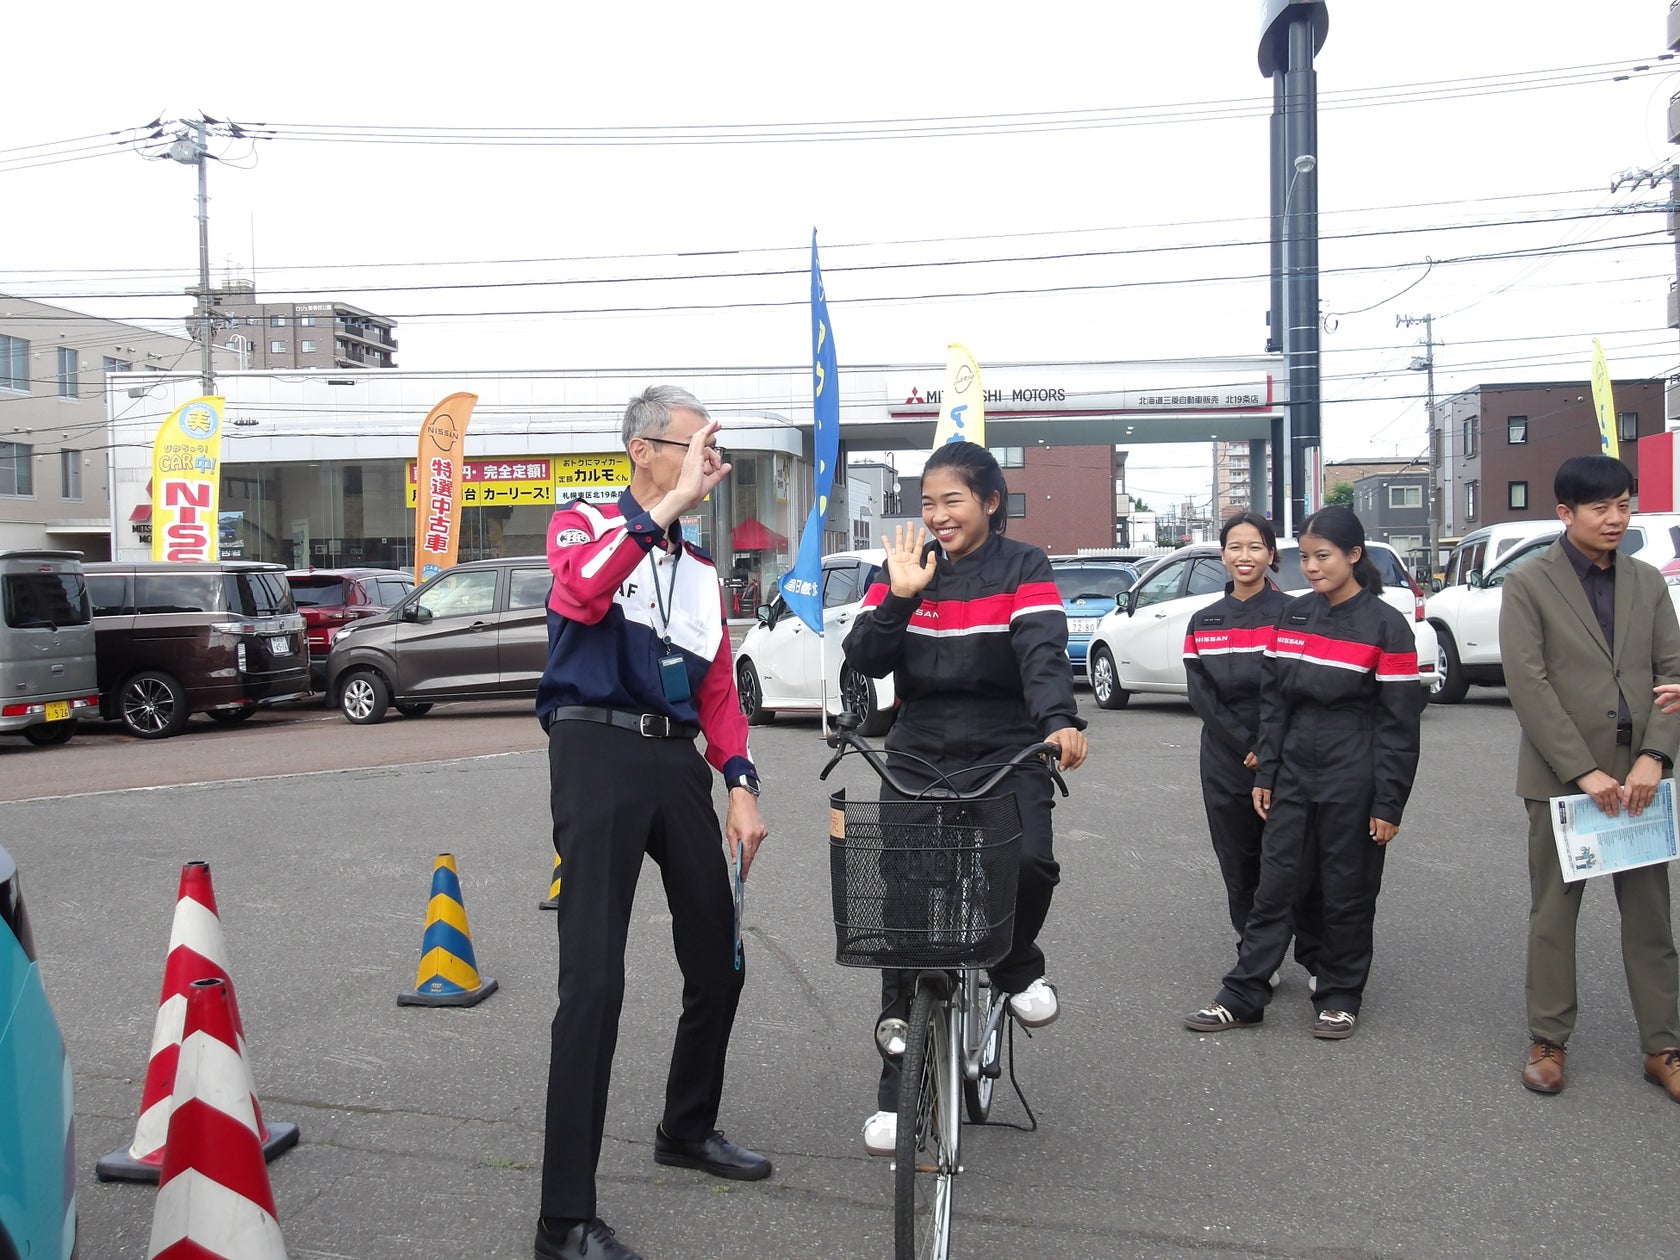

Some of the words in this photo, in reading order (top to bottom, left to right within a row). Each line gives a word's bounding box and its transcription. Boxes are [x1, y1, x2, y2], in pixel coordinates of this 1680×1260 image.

[926, 389, 1002, 403] MISHI
[1012, 388, 1065, 402] MOTORS
[1138, 395, 1219, 405] 北海道三菱自動車販売
[1225, 394, 1259, 404] 北19条店
[563, 458, 623, 467] おトクにマイカー
[483, 463, 547, 479] 完全定額!
[483, 487, 550, 500] カーリース!
[425, 459, 453, 551] 特選中古車
[1277, 636, 1305, 646] NISSAN
